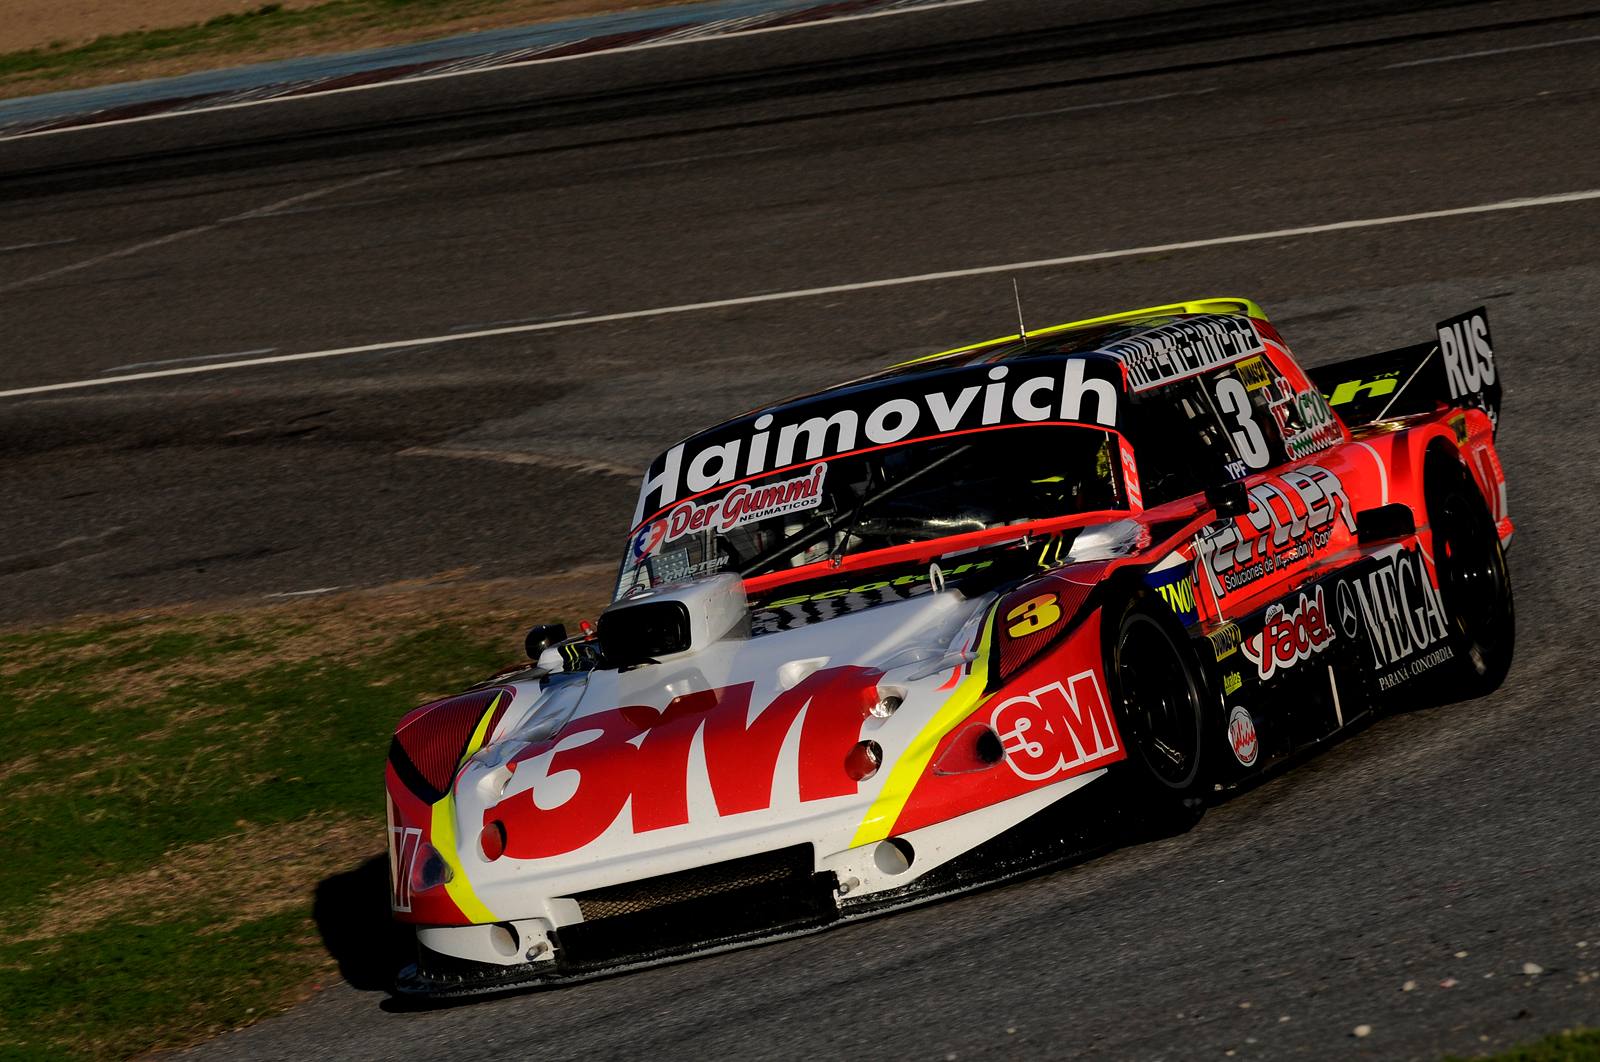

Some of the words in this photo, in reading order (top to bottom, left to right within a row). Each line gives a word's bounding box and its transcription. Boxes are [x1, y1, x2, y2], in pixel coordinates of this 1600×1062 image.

[1438, 314, 1496, 399] RUS
[632, 358, 1117, 532] Haimovich
[1215, 378, 1270, 469] 3
[669, 505, 720, 539] Der
[722, 466, 823, 529] Gummi
[739, 498, 818, 522] NEUMATICOS
[1224, 460, 1249, 480] YPF
[1225, 563, 1264, 592] Soluciones
[1264, 558, 1274, 573] de
[1308, 540, 1315, 557] y
[1006, 592, 1062, 639] 3
[1245, 590, 1328, 674] Fadel
[1352, 551, 1449, 670] MEGA
[483, 664, 884, 860] 3M
[991, 668, 1119, 782] 3M
